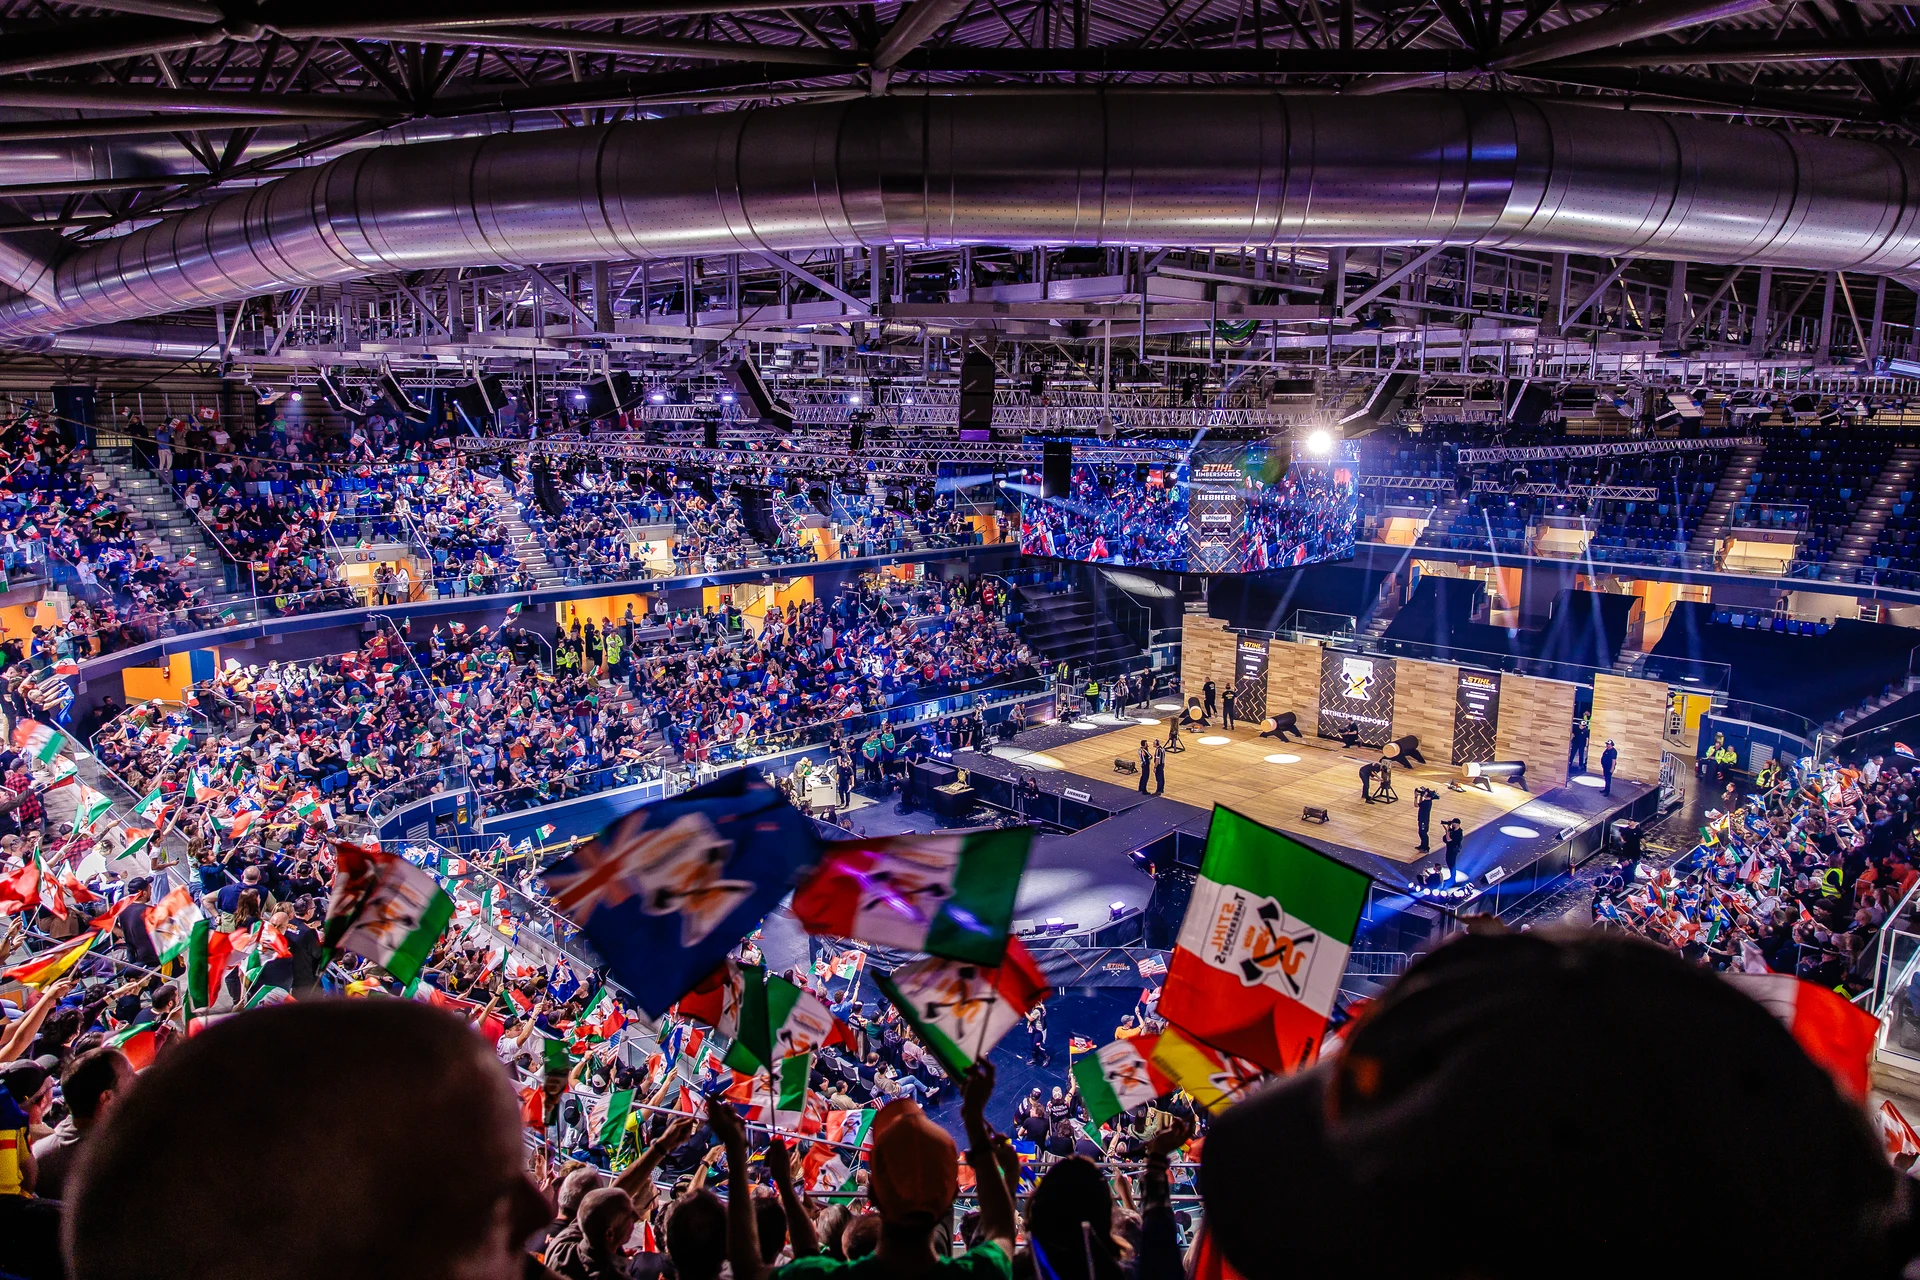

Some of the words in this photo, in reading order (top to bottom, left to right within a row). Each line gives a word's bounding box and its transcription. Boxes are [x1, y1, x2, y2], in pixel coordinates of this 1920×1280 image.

[1202, 464, 1235, 472] STIHL
[1194, 469, 1242, 477] TIMBERSPORTS
[1243, 641, 1262, 649] STIHL
[1467, 676, 1491, 685] STIHL
